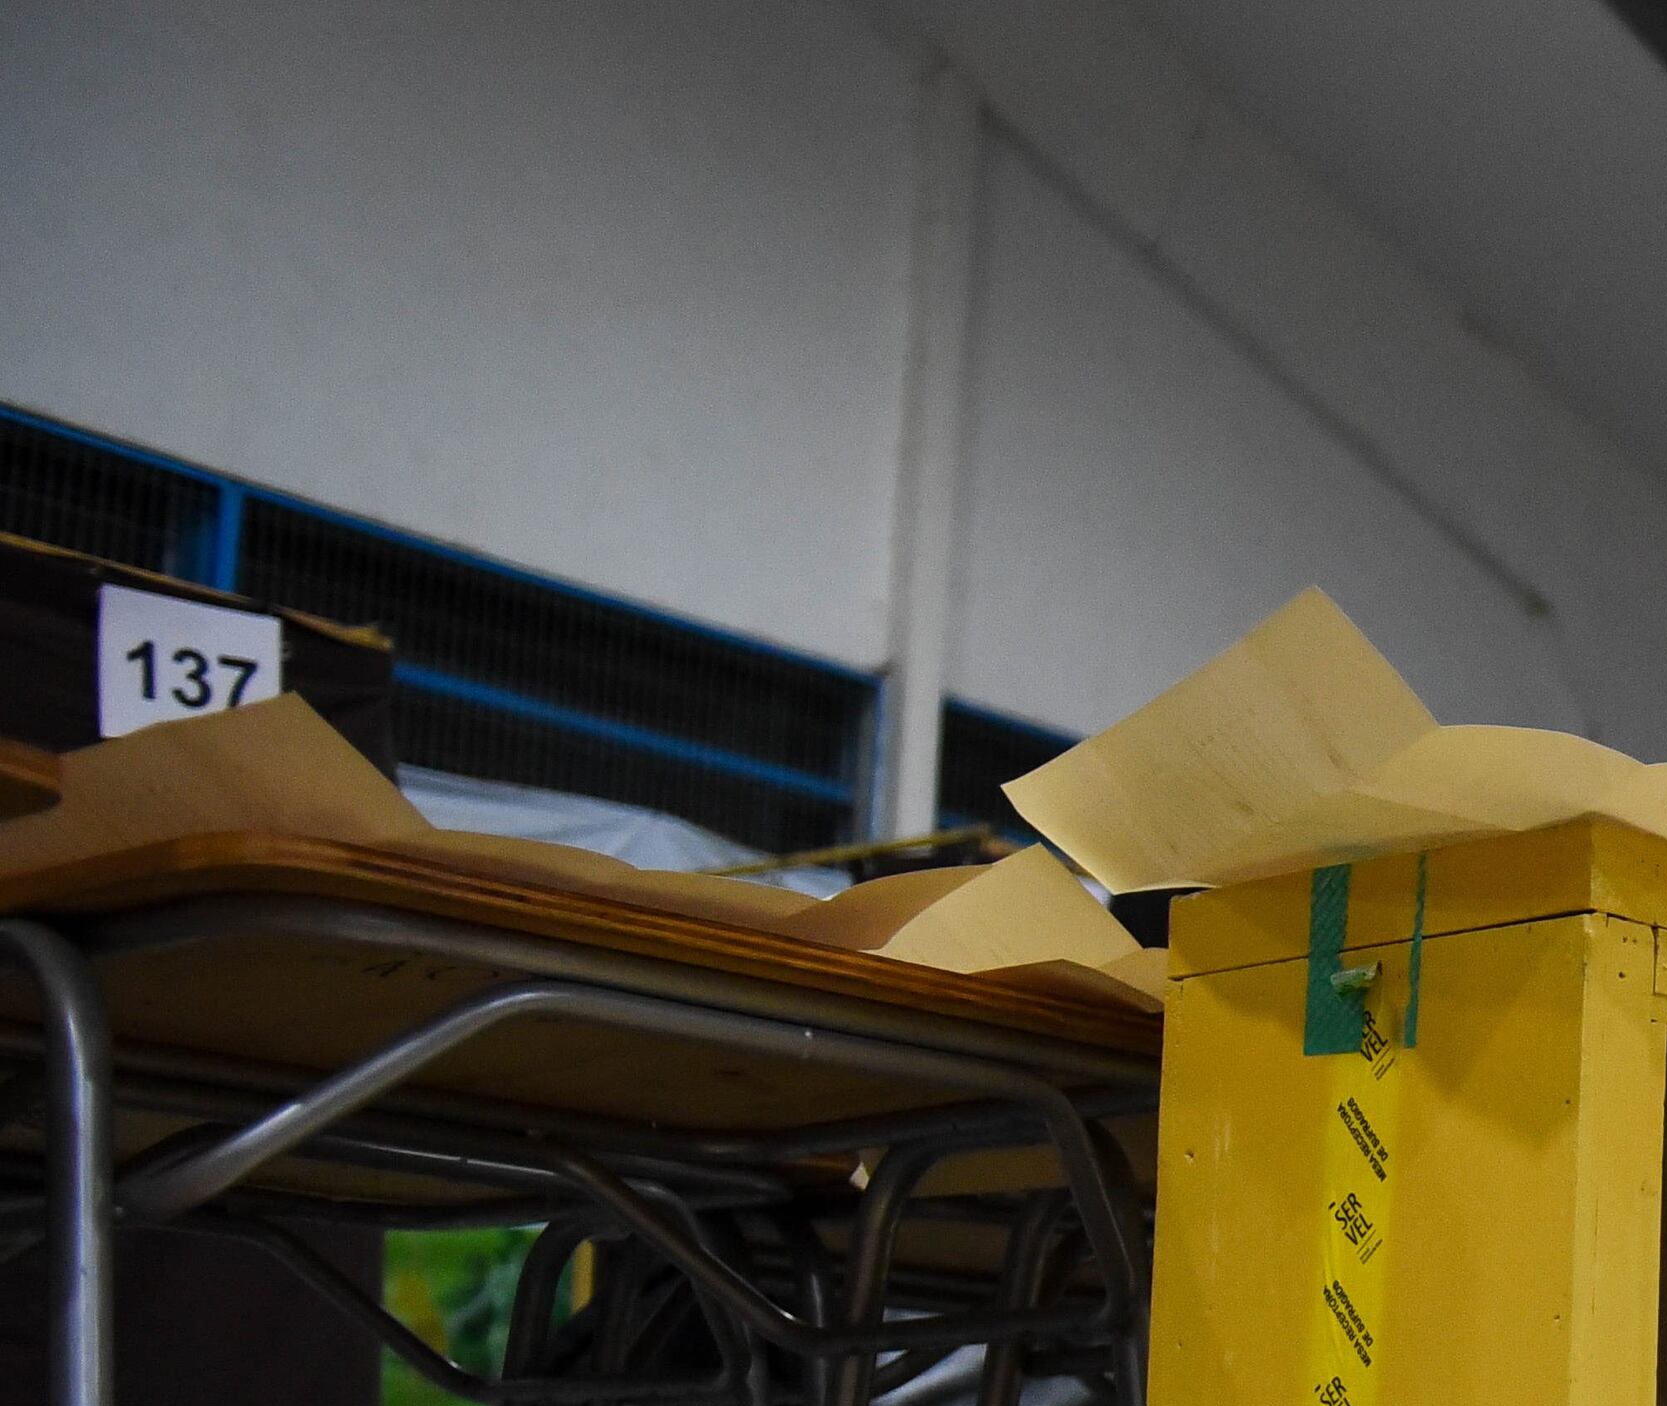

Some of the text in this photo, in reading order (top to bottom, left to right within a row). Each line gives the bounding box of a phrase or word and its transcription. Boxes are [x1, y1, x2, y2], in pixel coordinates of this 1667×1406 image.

[126, 640, 258, 708] 137
[1360, 1031, 1388, 1063] VEL
[1334, 1193, 1362, 1230] SER
[1344, 1213, 1374, 1246] VEL
